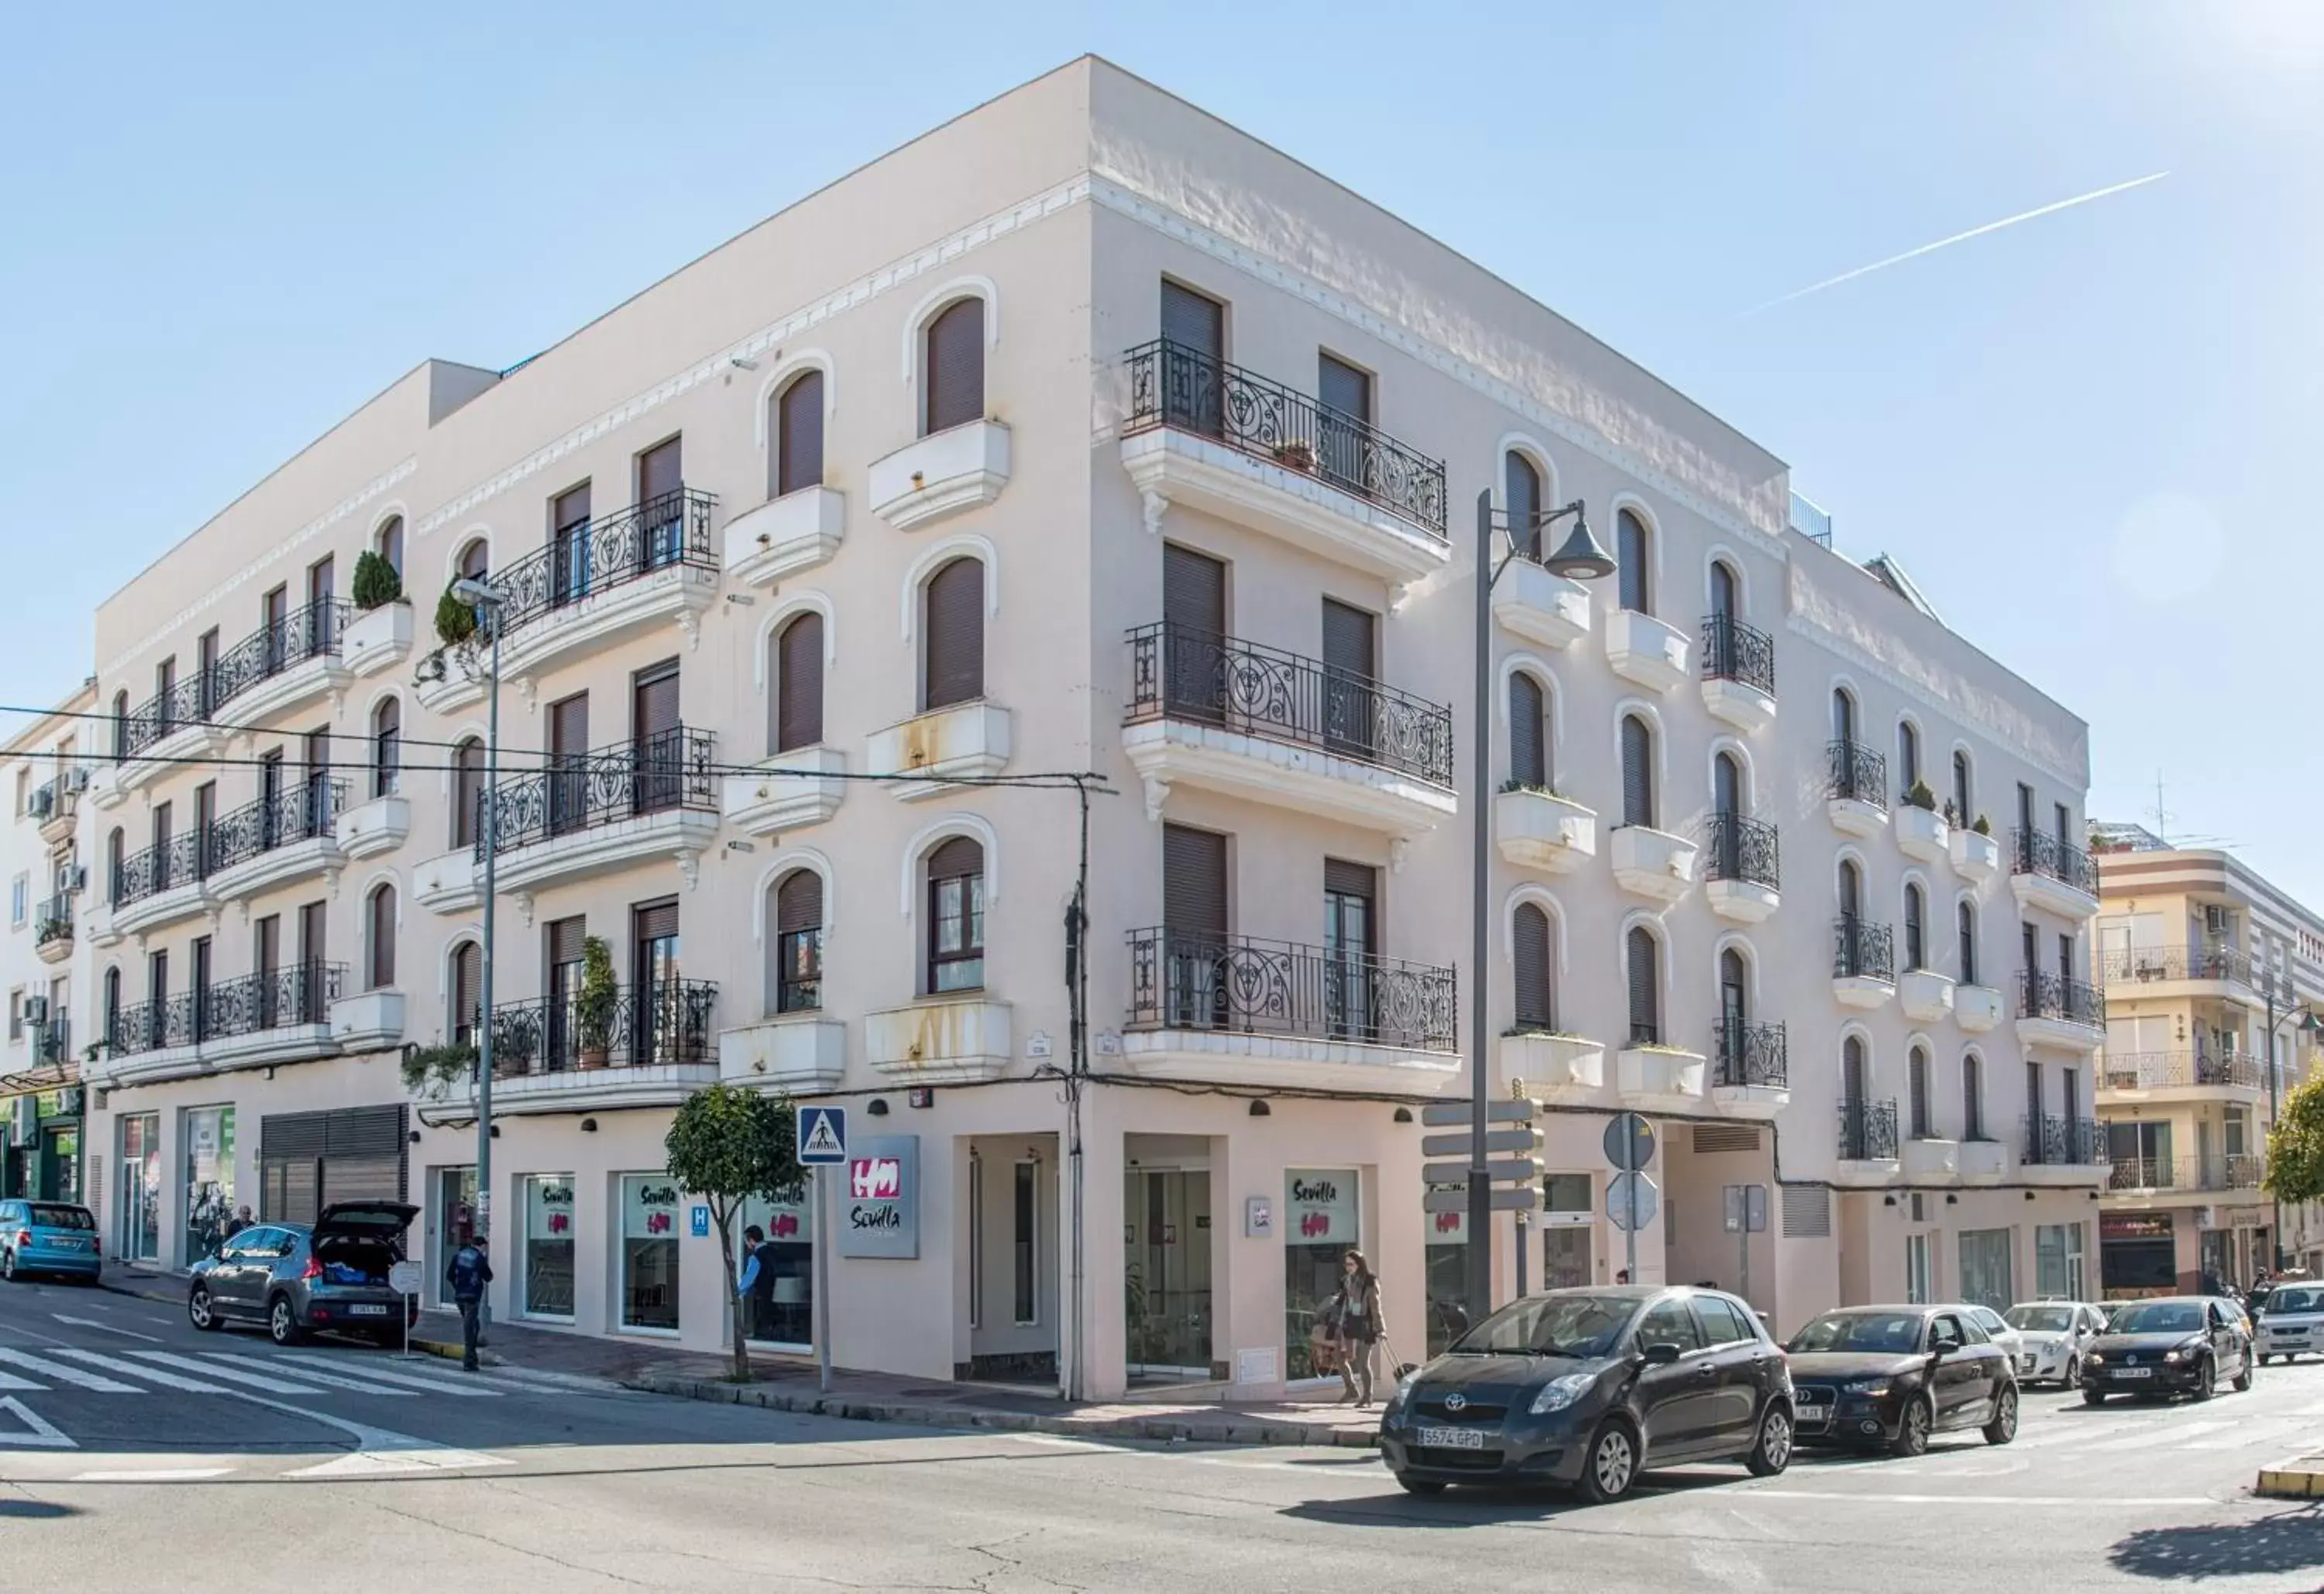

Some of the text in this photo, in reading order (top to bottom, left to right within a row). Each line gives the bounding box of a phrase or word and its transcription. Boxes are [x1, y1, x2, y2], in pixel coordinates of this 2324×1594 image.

[542, 1185, 572, 1204] Sevilla
[641, 1185, 677, 1205] Sevilla
[1293, 1178, 1336, 1203] Sevilla
[695, 1209, 705, 1225] H
[851, 1204, 900, 1229] Sevilla
